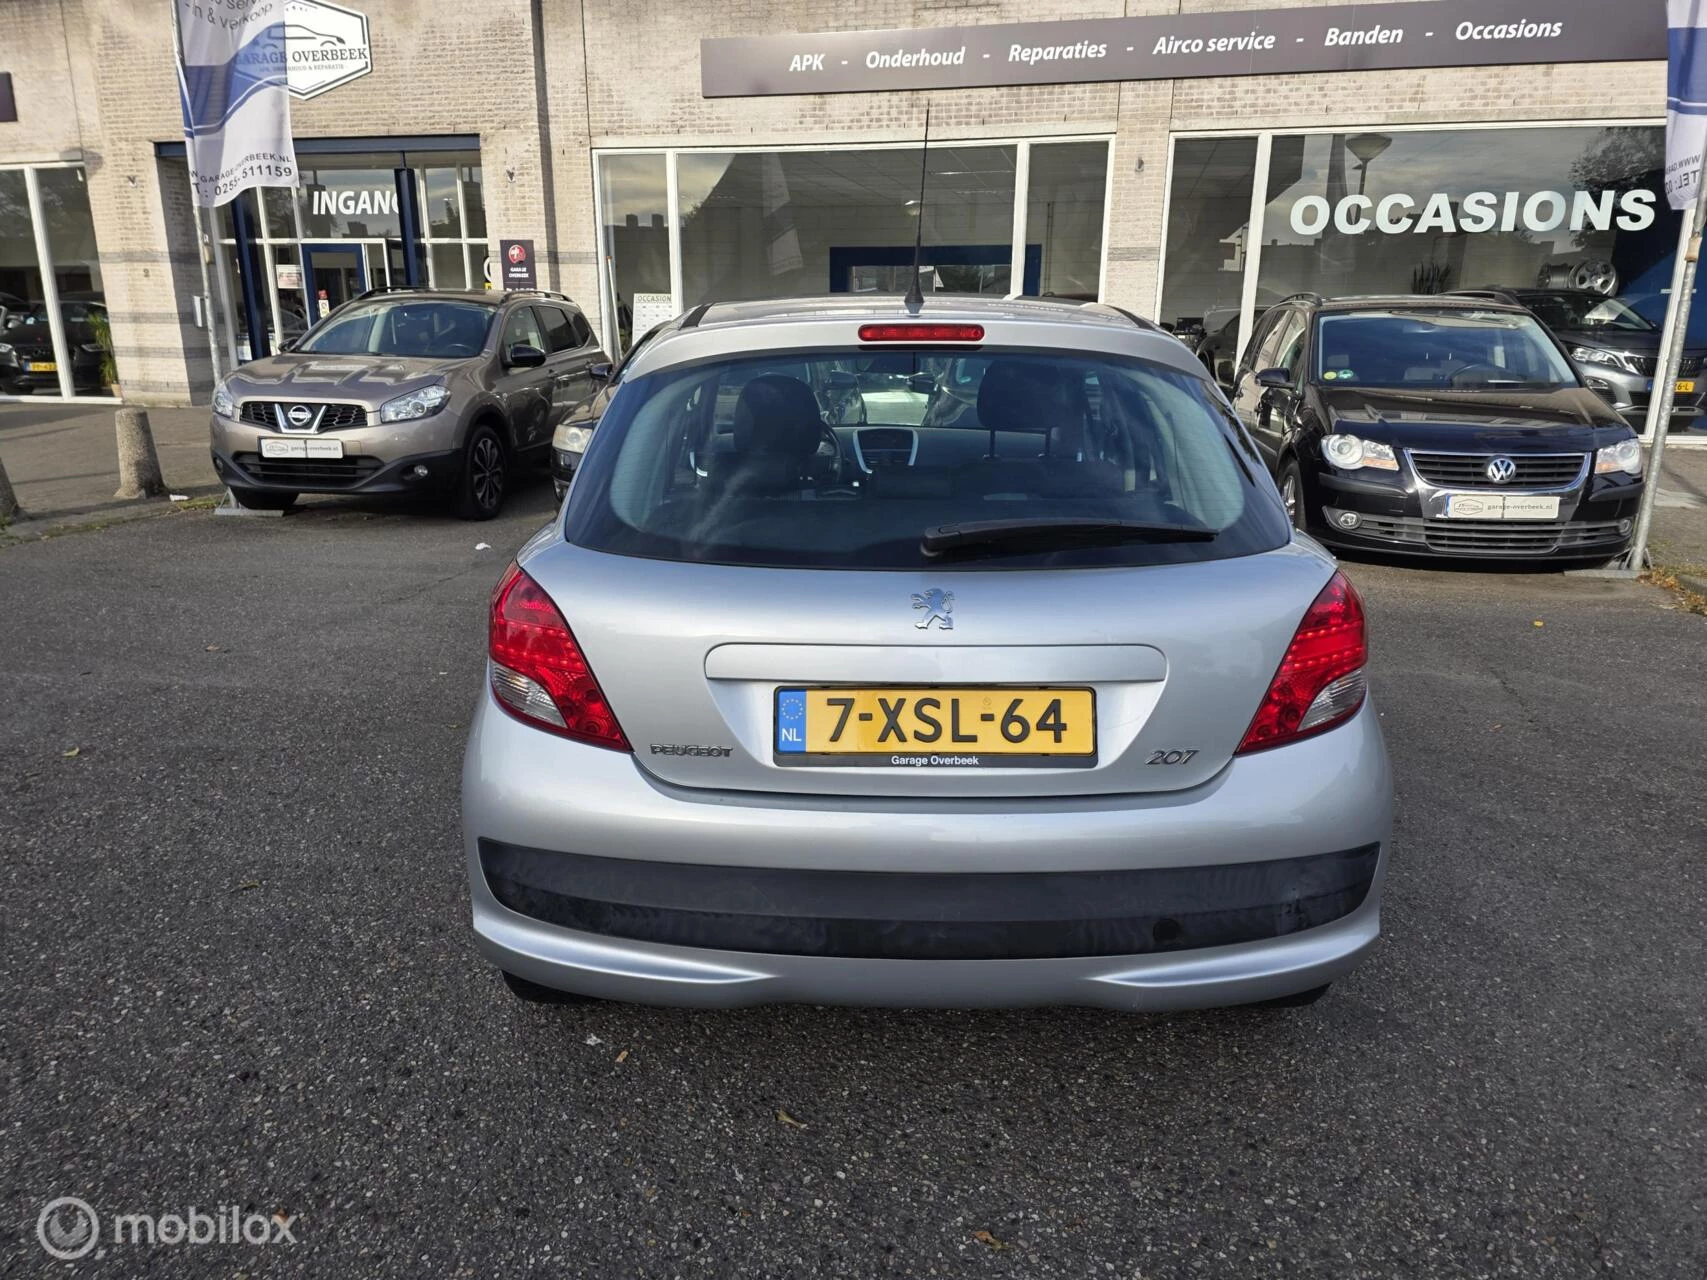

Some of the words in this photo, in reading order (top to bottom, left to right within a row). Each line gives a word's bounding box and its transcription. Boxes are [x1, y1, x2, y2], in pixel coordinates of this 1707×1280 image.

[789, 53, 825, 72] APK
[866, 46, 965, 69] Onderhoud
[1008, 40, 1107, 67] Reparaties
[1152, 35, 1203, 55] Airco
[1206, 31, 1276, 52] service
[1324, 25, 1403, 46] Banden
[1455, 18, 1563, 41] Occasions
[292, 47, 368, 63] OVERBEEK
[1289, 189, 1657, 236] OCCASIONS
[781, 727, 802, 742] NL
[826, 697, 1067, 744] 7-XSL-64
[650, 744, 733, 758] PEUGEOT
[1145, 748, 1200, 765] 207
[891, 755, 928, 767] Garage
[930, 754, 979, 765] Overbeek
